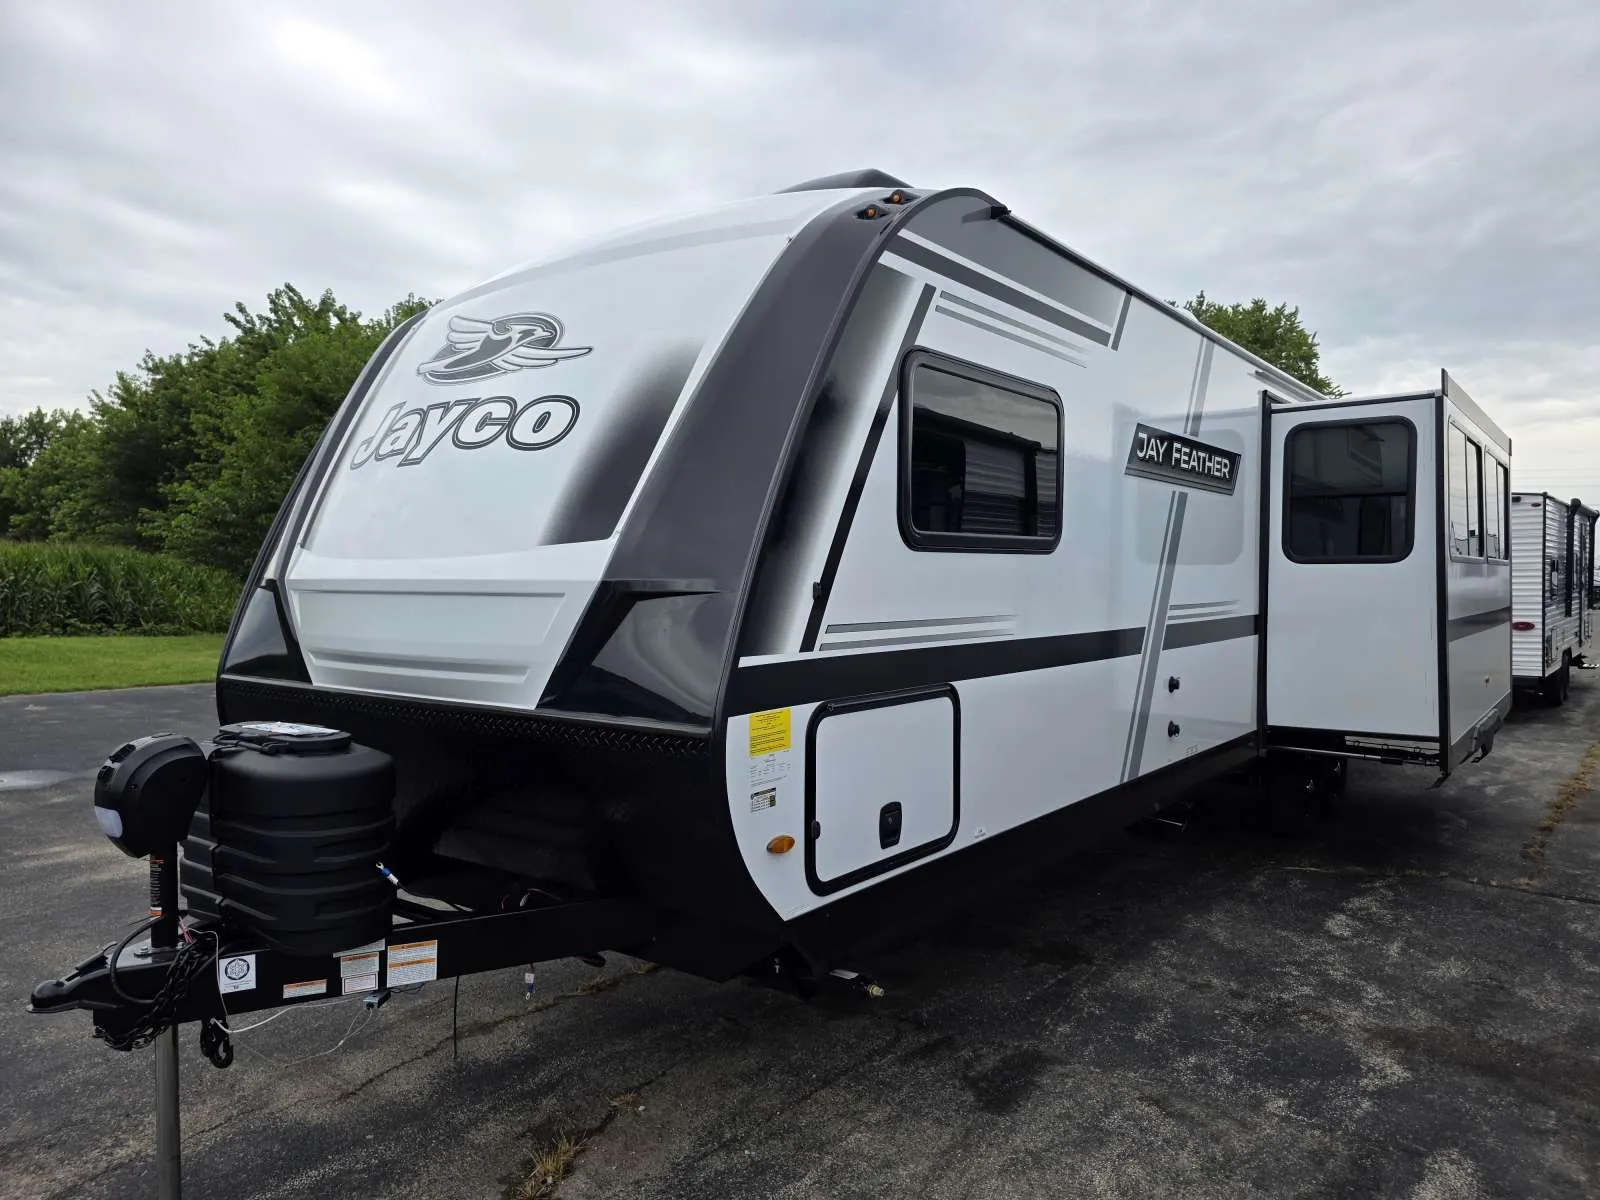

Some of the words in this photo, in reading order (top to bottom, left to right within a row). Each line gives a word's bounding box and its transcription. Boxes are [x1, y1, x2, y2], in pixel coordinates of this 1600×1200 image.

[350, 395, 581, 470] Jayco
[1136, 432, 1168, 463] JAY
[1171, 442, 1230, 479] FEATHER
